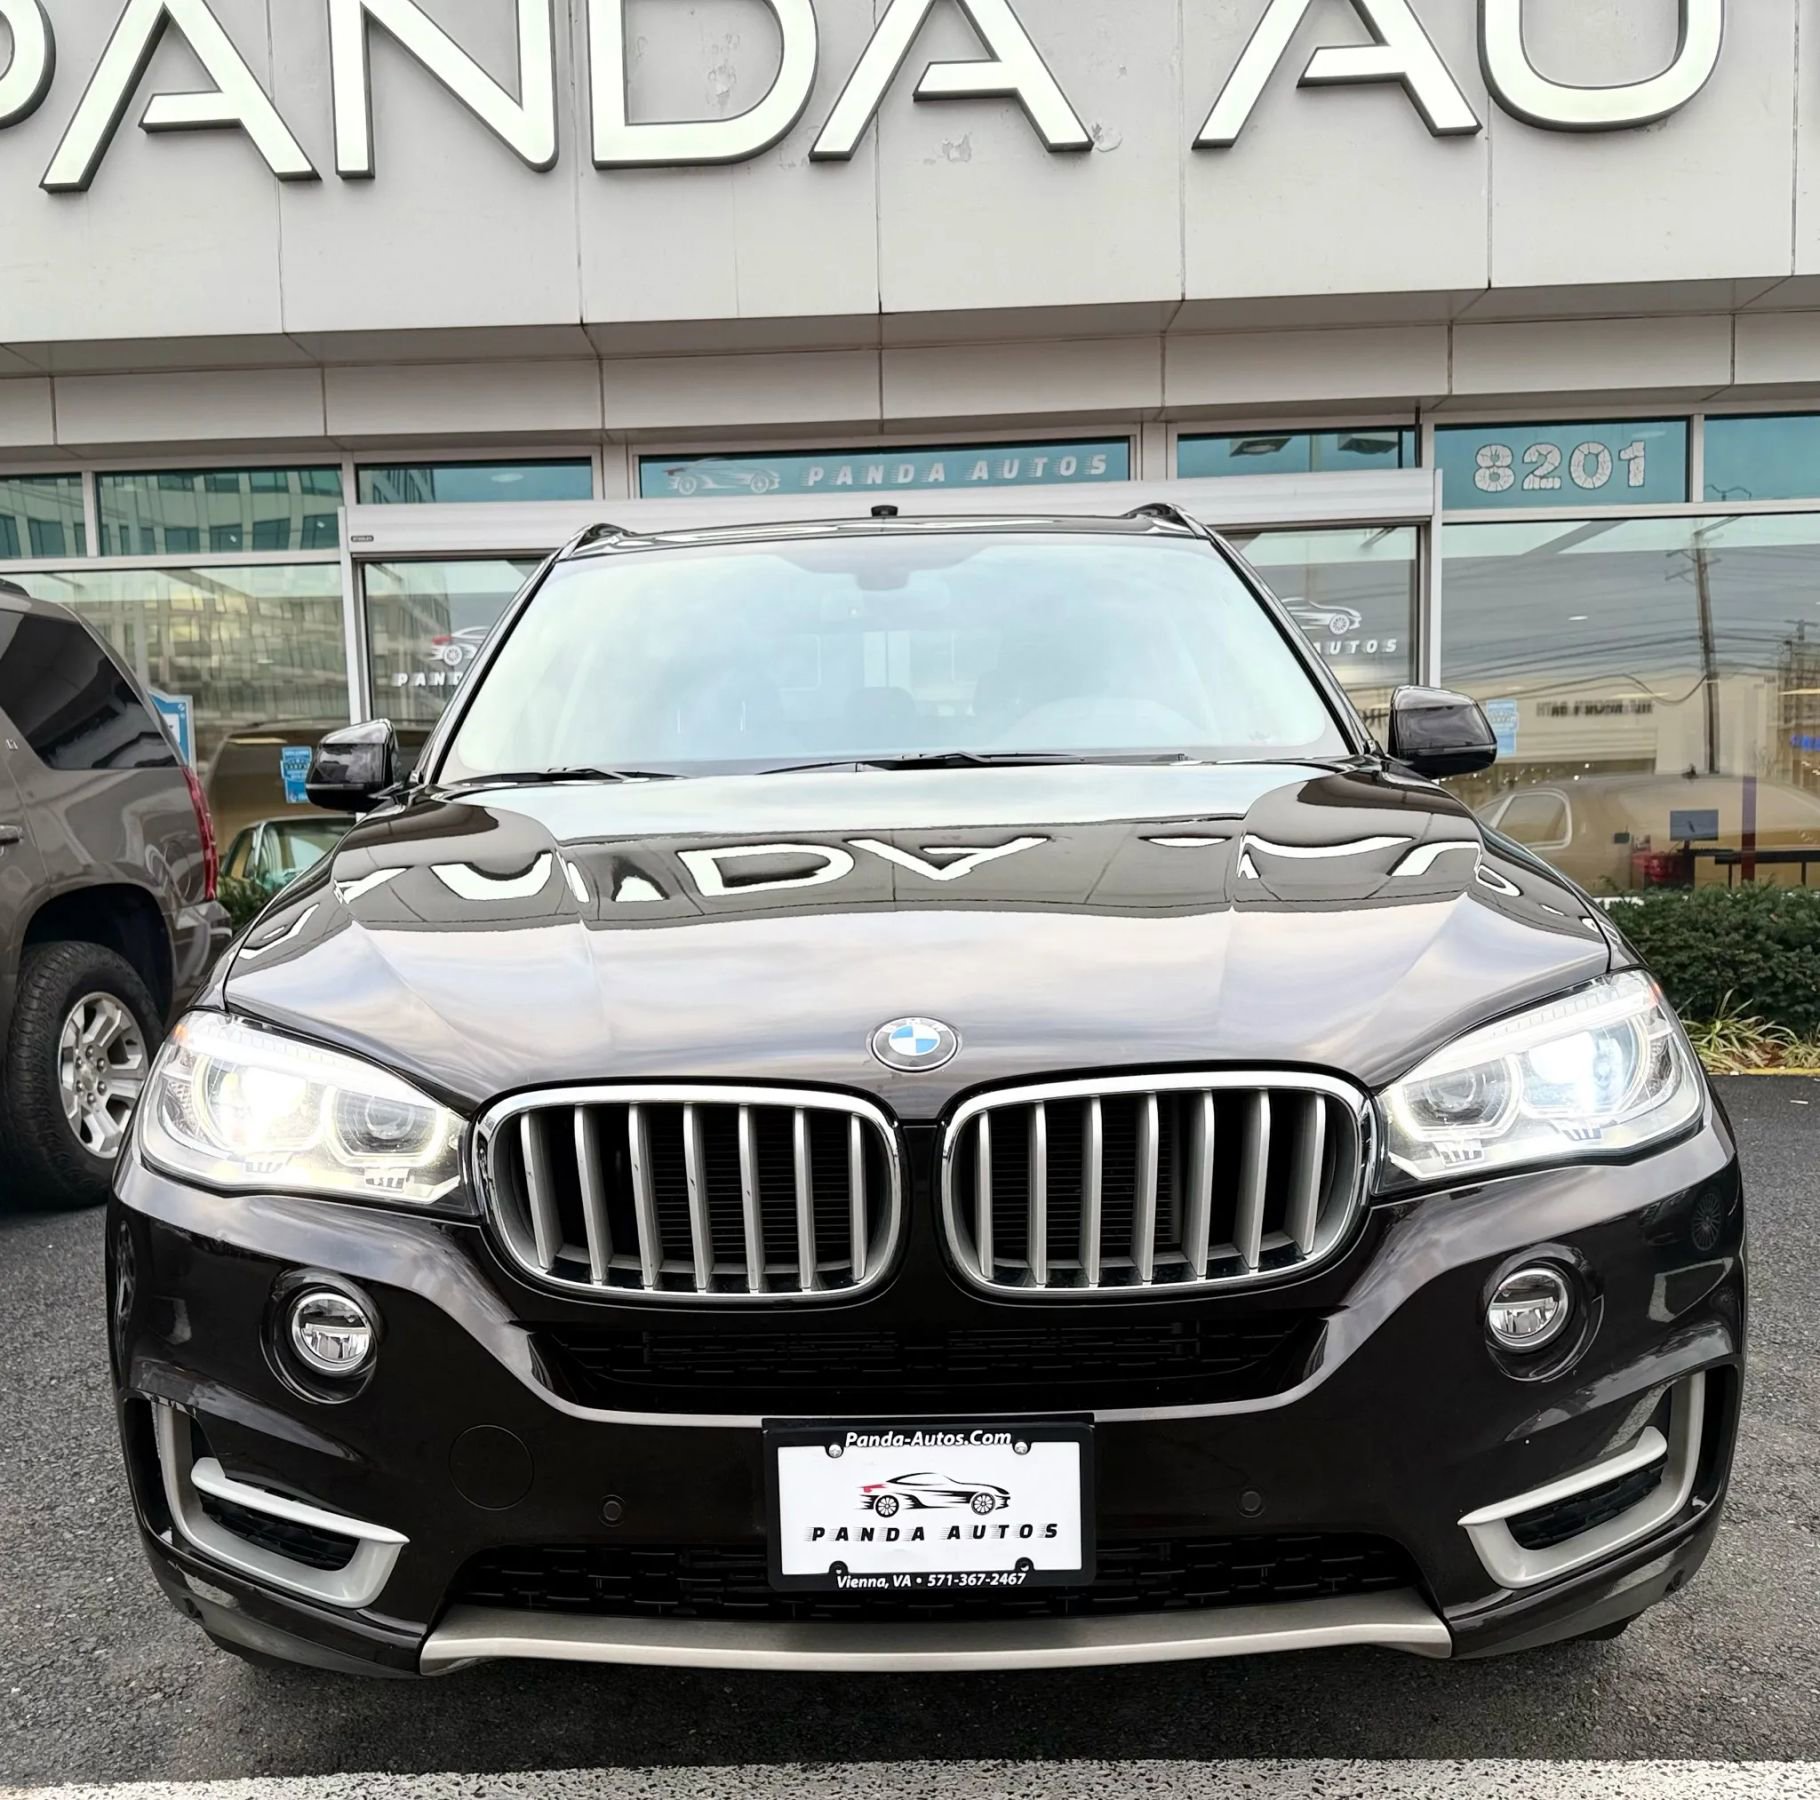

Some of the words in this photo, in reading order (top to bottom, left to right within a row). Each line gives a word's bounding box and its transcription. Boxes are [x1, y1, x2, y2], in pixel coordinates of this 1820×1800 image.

[0, 0, 1092, 193] ANDA
[803, 463, 946, 487] PANDA
[963, 454, 1107, 480] AUTOS
[1473, 440, 1646, 493] 8201
[845, 1429, 1012, 1448] Panda-Autos.Com
[805, 1525, 925, 1542] PANDA
[942, 1523, 1058, 1540] AUTOS
[836, 1574, 889, 1589] Vienna,
[893, 1574, 912, 1588] VA
[927, 1572, 1026, 1588] 571-367-2467
